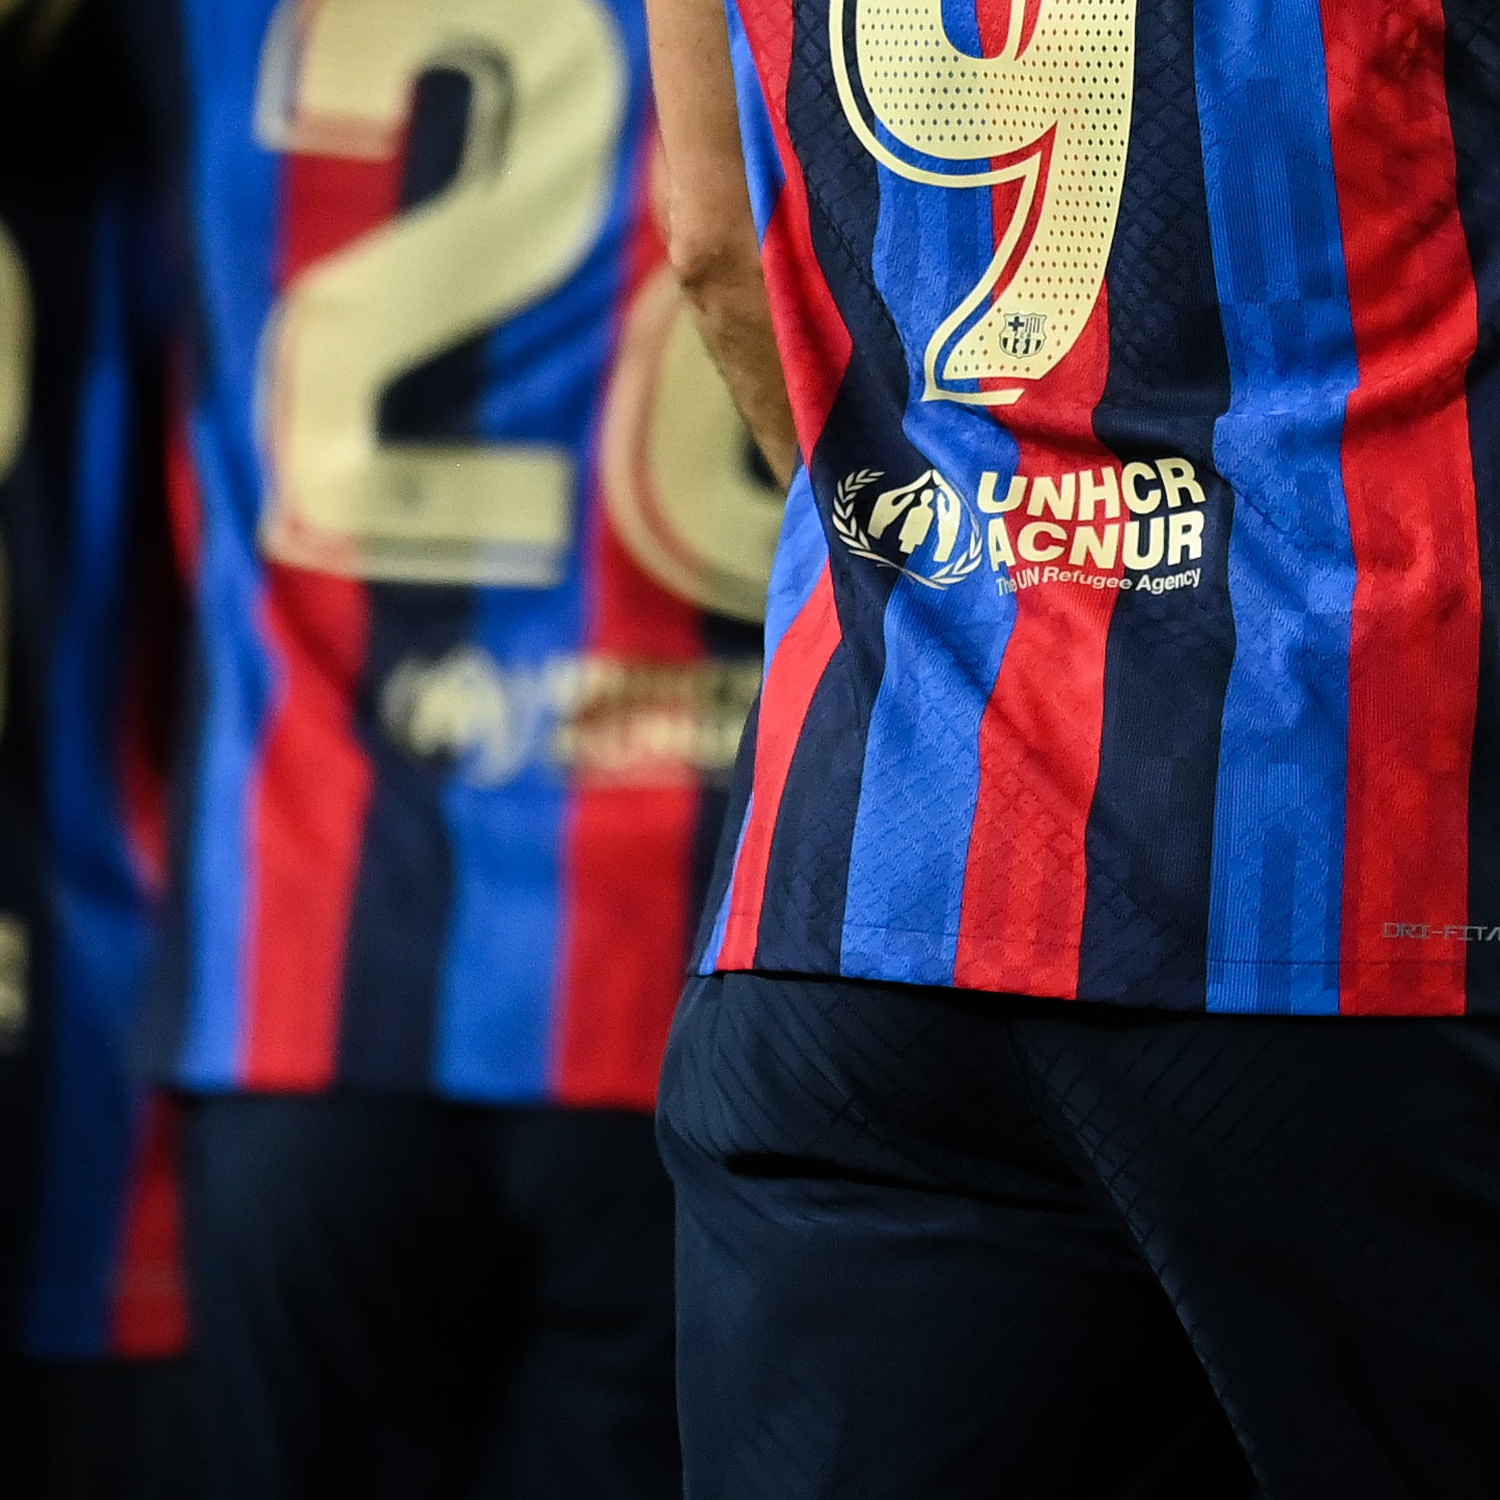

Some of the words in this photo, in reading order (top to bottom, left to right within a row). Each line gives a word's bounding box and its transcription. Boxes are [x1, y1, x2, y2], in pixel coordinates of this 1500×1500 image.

[977, 457, 1207, 522] UNHCR
[988, 510, 1205, 573] ACNUR
[996, 577, 1019, 597] The
[1017, 566, 1041, 590] UN
[1041, 566, 1133, 590] Refugee
[1134, 567, 1202, 596] Agency
